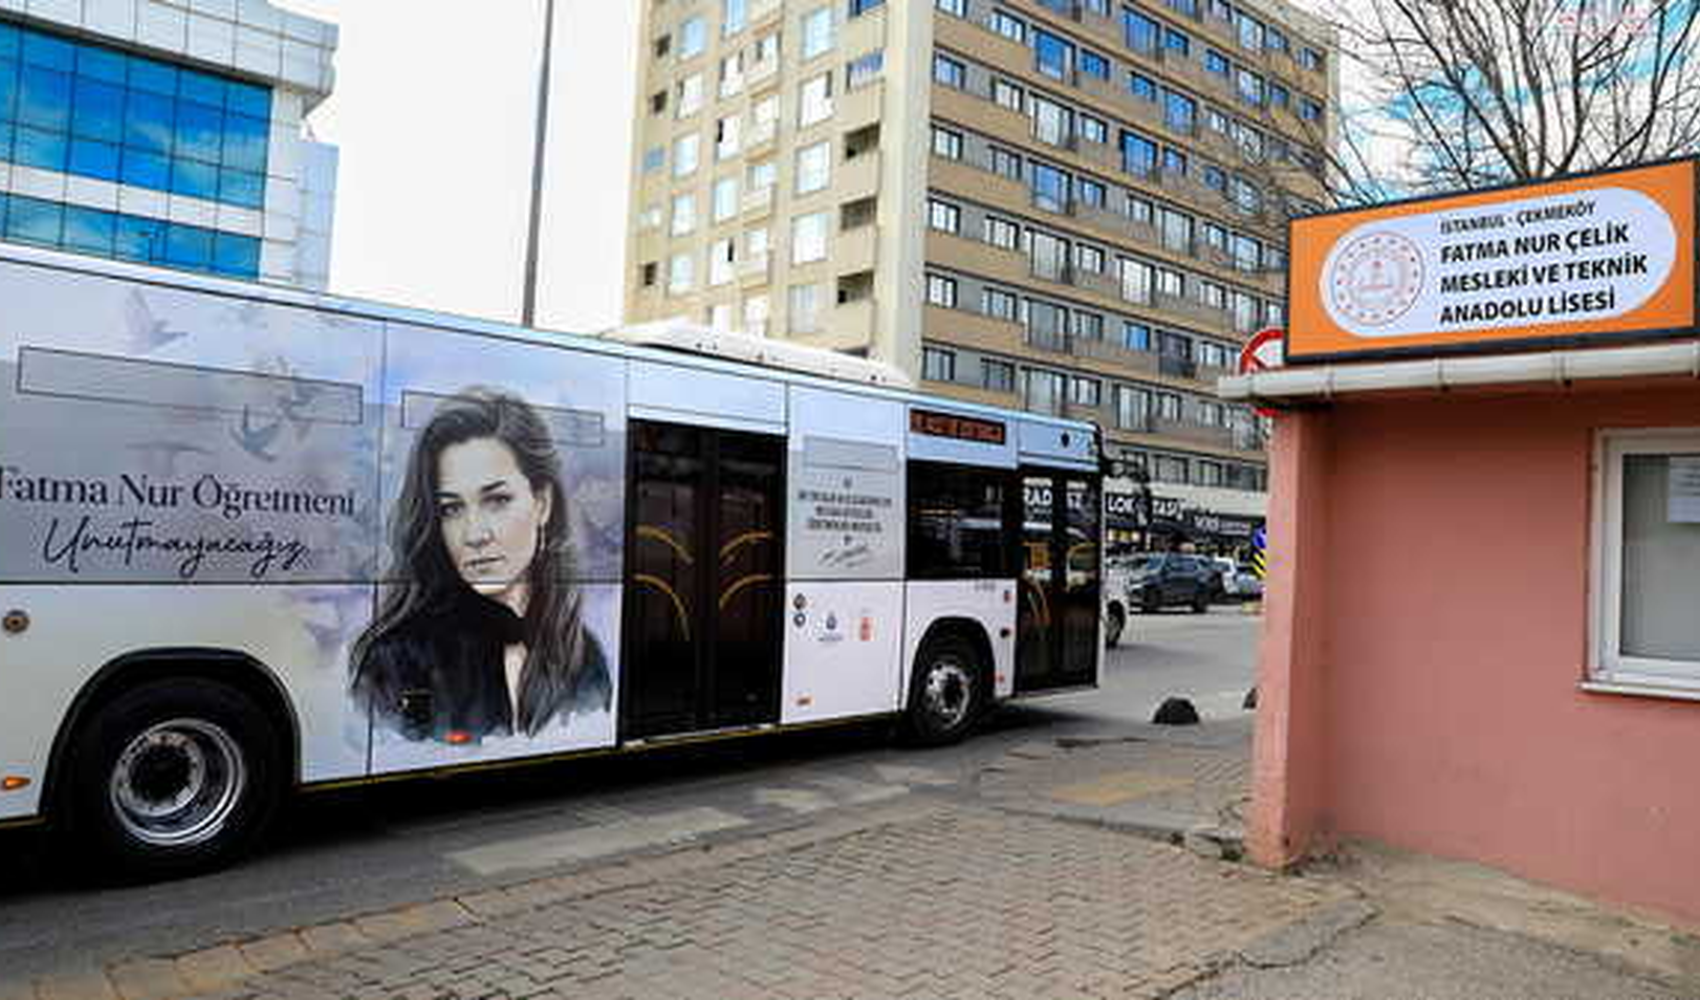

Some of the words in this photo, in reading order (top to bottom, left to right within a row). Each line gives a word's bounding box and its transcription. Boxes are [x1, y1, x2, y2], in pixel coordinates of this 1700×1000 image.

[1441, 239, 1510, 263] FATMA
[1514, 234, 1561, 255] NUR
[1565, 222, 1629, 254] ÇELİK
[1440, 264, 1528, 294] MESLEKİ
[1532, 264, 1559, 284] VE
[1564, 252, 1647, 281] TEKNİK
[1440, 297, 1542, 325] ANADOLU
[1549, 285, 1615, 314] LİSESİ
[117, 473, 184, 508] Nur
